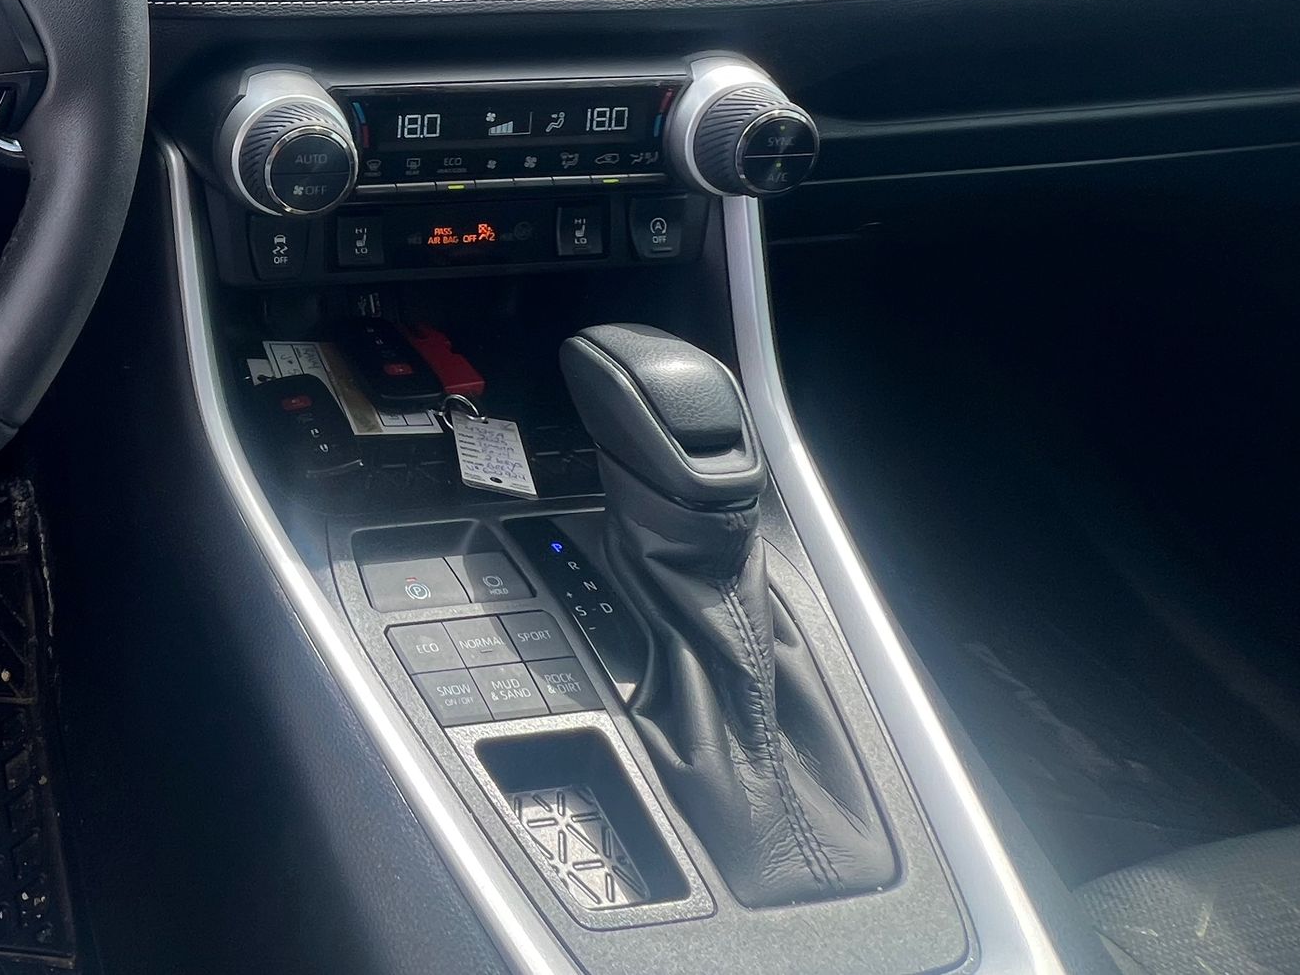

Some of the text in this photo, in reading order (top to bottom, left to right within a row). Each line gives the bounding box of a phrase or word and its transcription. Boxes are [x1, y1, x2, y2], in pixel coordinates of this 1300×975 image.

[295, 154, 328, 165] AUTO
[443, 157, 462, 166] ECO
[767, 172, 788, 183] A/C
[305, 185, 327, 196] OFF
[434, 227, 453, 236] PASS
[428, 234, 478, 245] AIR BAG OFF
[273, 256, 288, 264] OFF
[551, 543, 562, 553] P
[567, 561, 580, 570] R
[583, 581, 597, 590] N
[575, 603, 613, 616] S D
[517, 630, 551, 642] SPORT
[416, 642, 440, 654] ECO
[491, 678, 520, 690] MUD
[544, 673, 575, 685] ROCK
[436, 684, 471, 697] SNOW
[557, 682, 582, 694] DIRT
[500, 688, 532, 701] SAND
